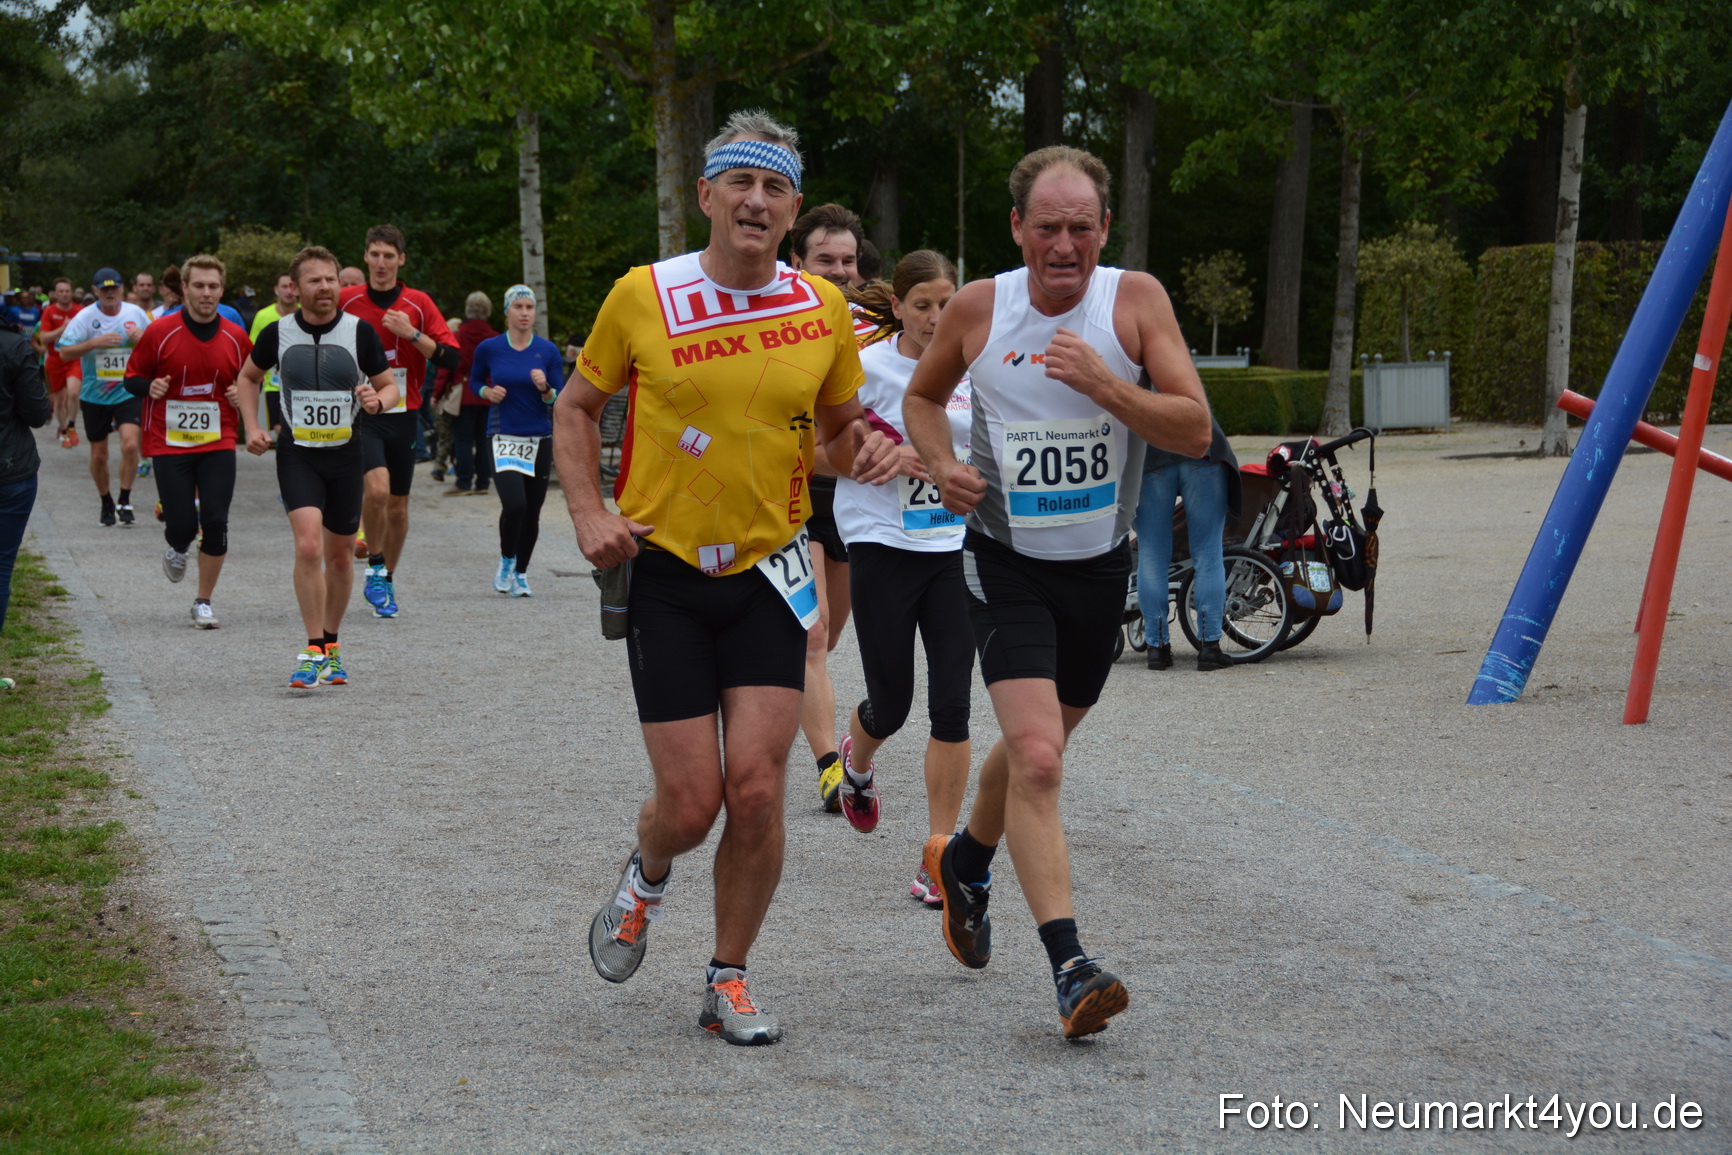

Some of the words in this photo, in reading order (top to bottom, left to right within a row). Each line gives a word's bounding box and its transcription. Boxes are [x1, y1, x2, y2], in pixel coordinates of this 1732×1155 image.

[671, 334, 752, 368] MAX
[758, 318, 833, 350] BÖGL
[103, 356, 125, 369] 341
[178, 412, 210, 430] 229
[303, 404, 341, 426] 360
[309, 430, 335, 440] Oliver
[1006, 431, 1043, 442] PARTL
[1045, 429, 1100, 441] Neumarkt
[498, 442, 534, 461] 2242
[1015, 442, 1110, 487] 2058
[908, 475, 942, 506] 23
[1037, 493, 1091, 513] Roland
[929, 512, 956, 526] Heike
